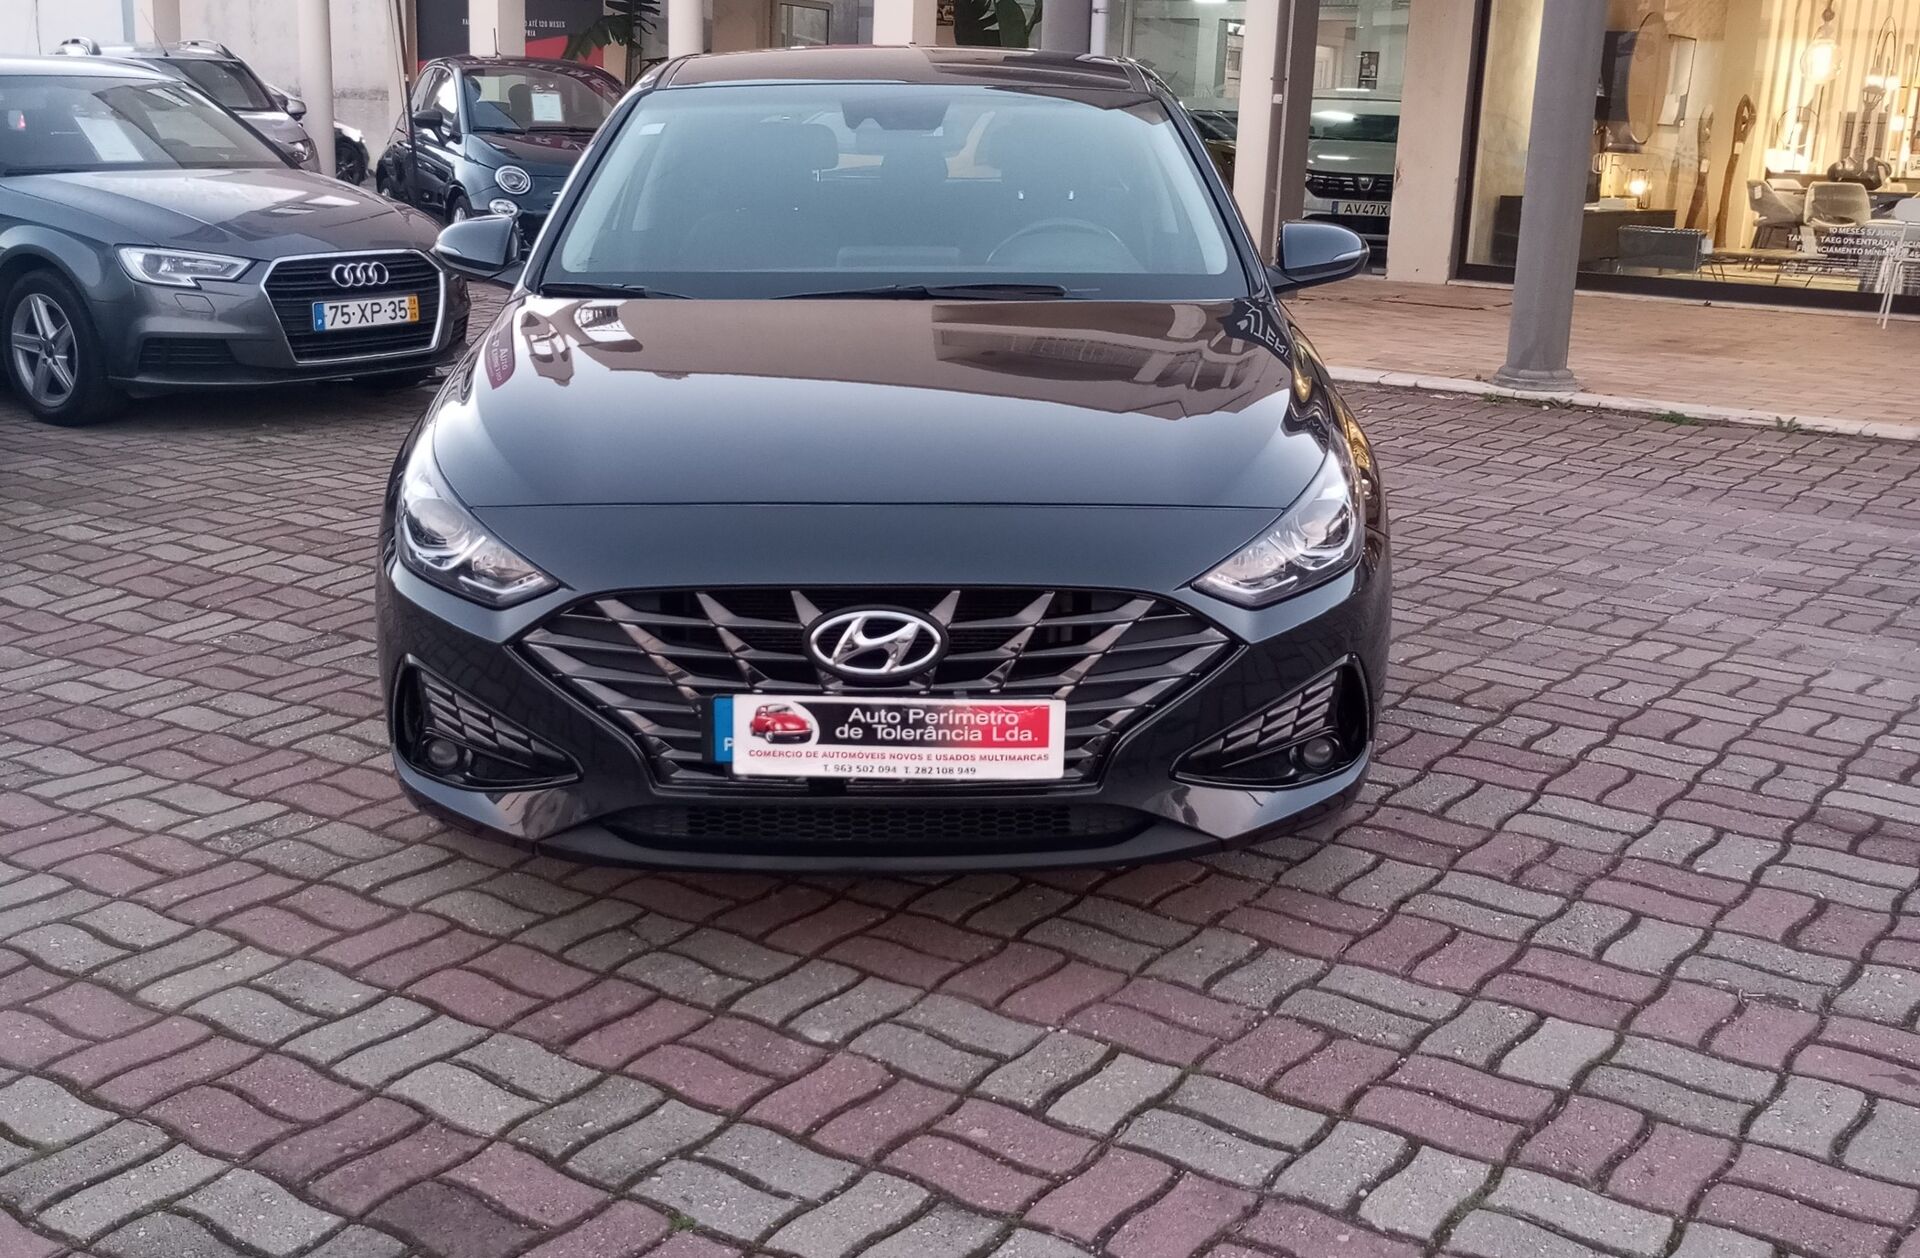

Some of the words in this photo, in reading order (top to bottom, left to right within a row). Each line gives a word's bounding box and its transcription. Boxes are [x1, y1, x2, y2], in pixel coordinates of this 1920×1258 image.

[1838, 228, 1865, 236] MESES
[1820, 235, 1841, 243] TAEG
[1842, 237, 1855, 245] 0%
[848, 707, 901, 724] Auto
[908, 707, 1019, 726] Perímetro
[835, 723, 863, 739] de
[872, 724, 982, 742] Tolerância
[992, 726, 1039, 742] Lda.
[805, 750, 819, 758] DE
[821, 750, 886, 760] AUTOMÓVEIS
[889, 752, 923, 760] NOVOS
[935, 753, 976, 761] USADOS
[979, 753, 1049, 761] MULTIMARCAS
[834, 764, 853, 773] 963
[856, 764, 875, 773] 502
[878, 765, 897, 773] 094
[914, 766, 933, 775] 282
[936, 766, 954, 775] 108
[957, 766, 976, 775] 949
